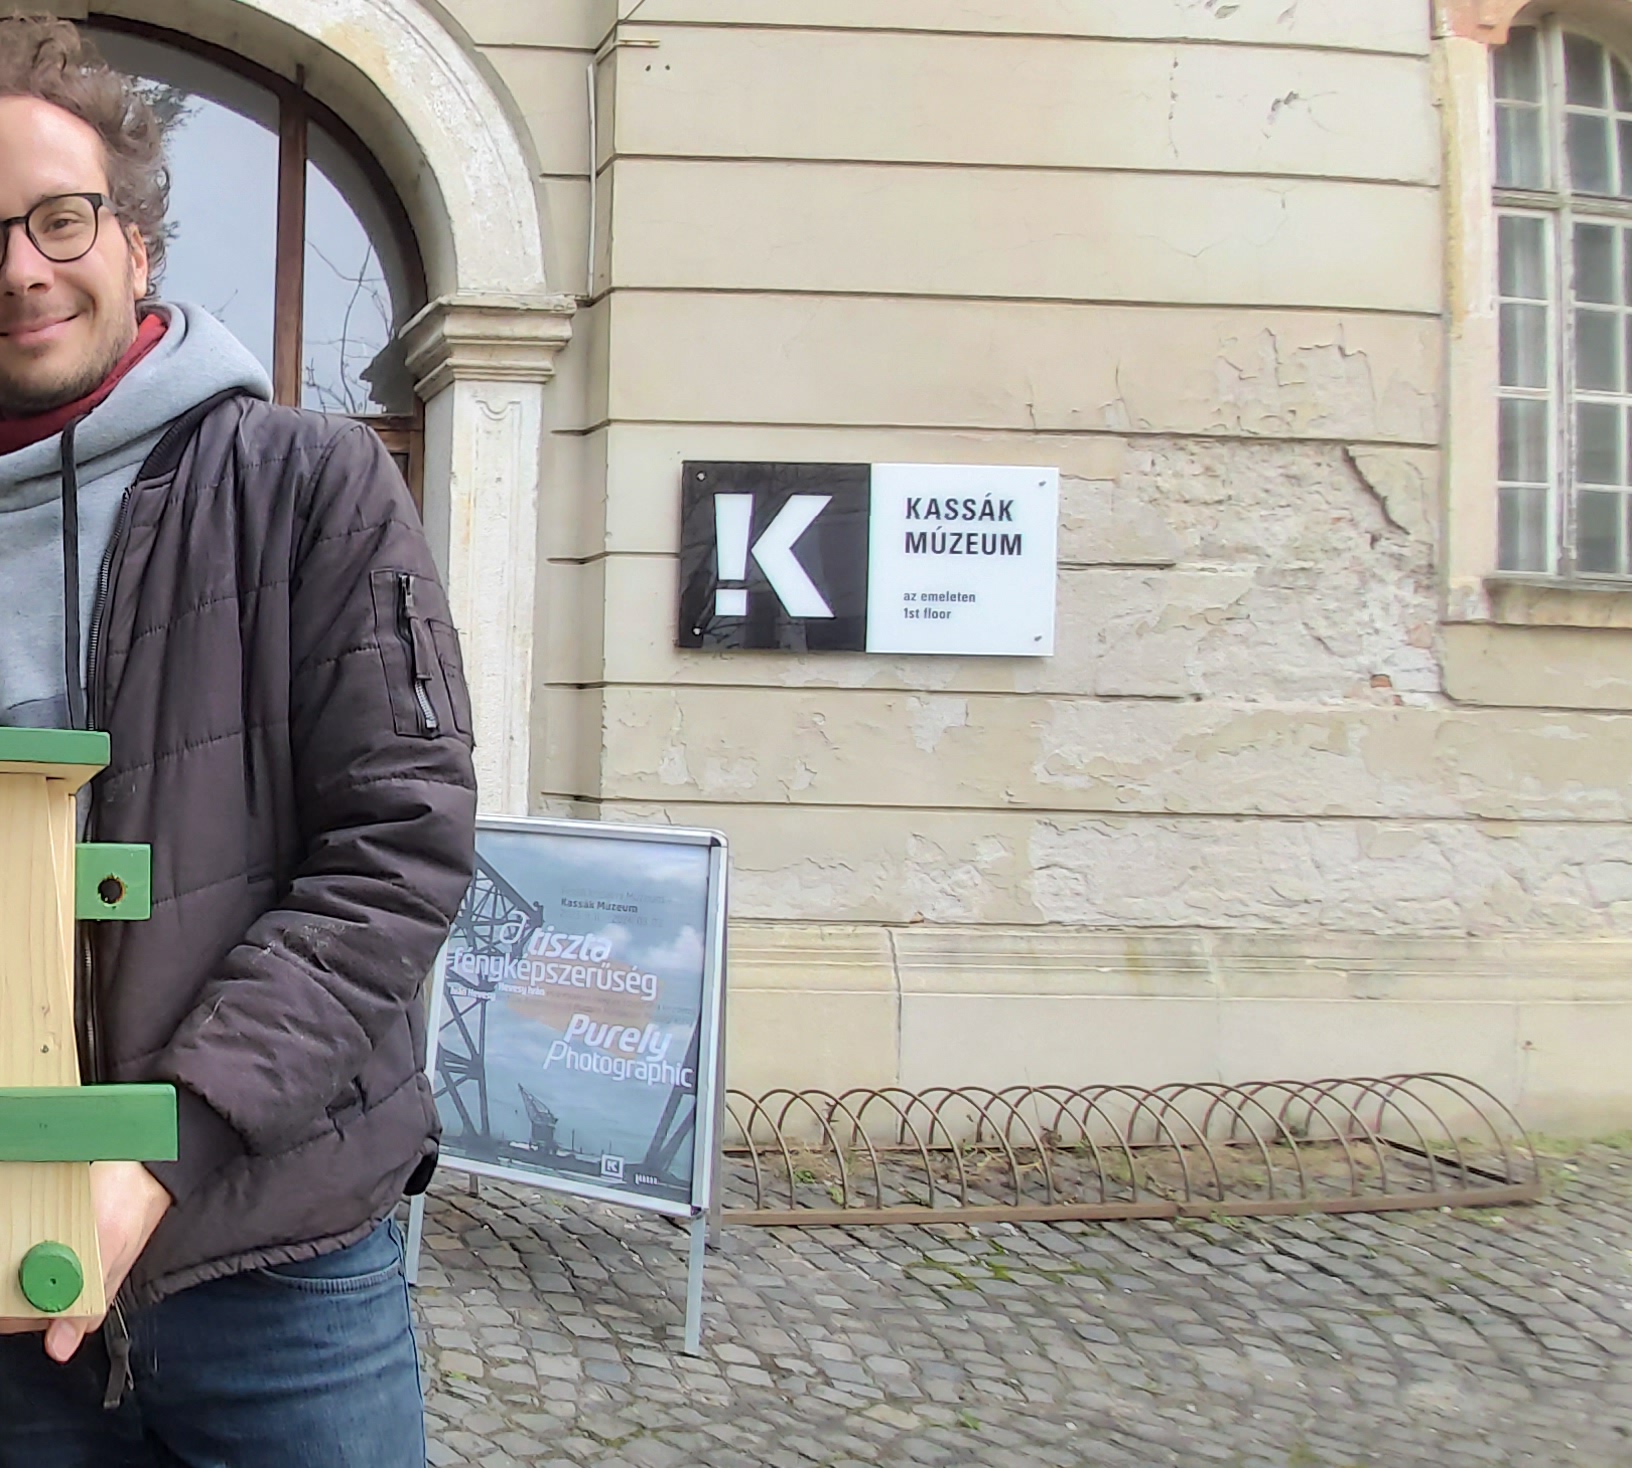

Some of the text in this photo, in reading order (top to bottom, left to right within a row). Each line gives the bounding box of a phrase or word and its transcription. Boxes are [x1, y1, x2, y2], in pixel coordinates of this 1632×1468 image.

[906, 492, 1014, 522] KASSÁK
[905, 526, 1023, 556] MÚZEUM
[903, 591, 976, 603] az emeleten
[903, 607, 952, 620] 1st floor
[527, 925, 613, 963] tiszta
[452, 946, 658, 1001] fényképszerűség
[563, 1013, 672, 1062] Purely
[542, 1040, 695, 1088] Photographic
